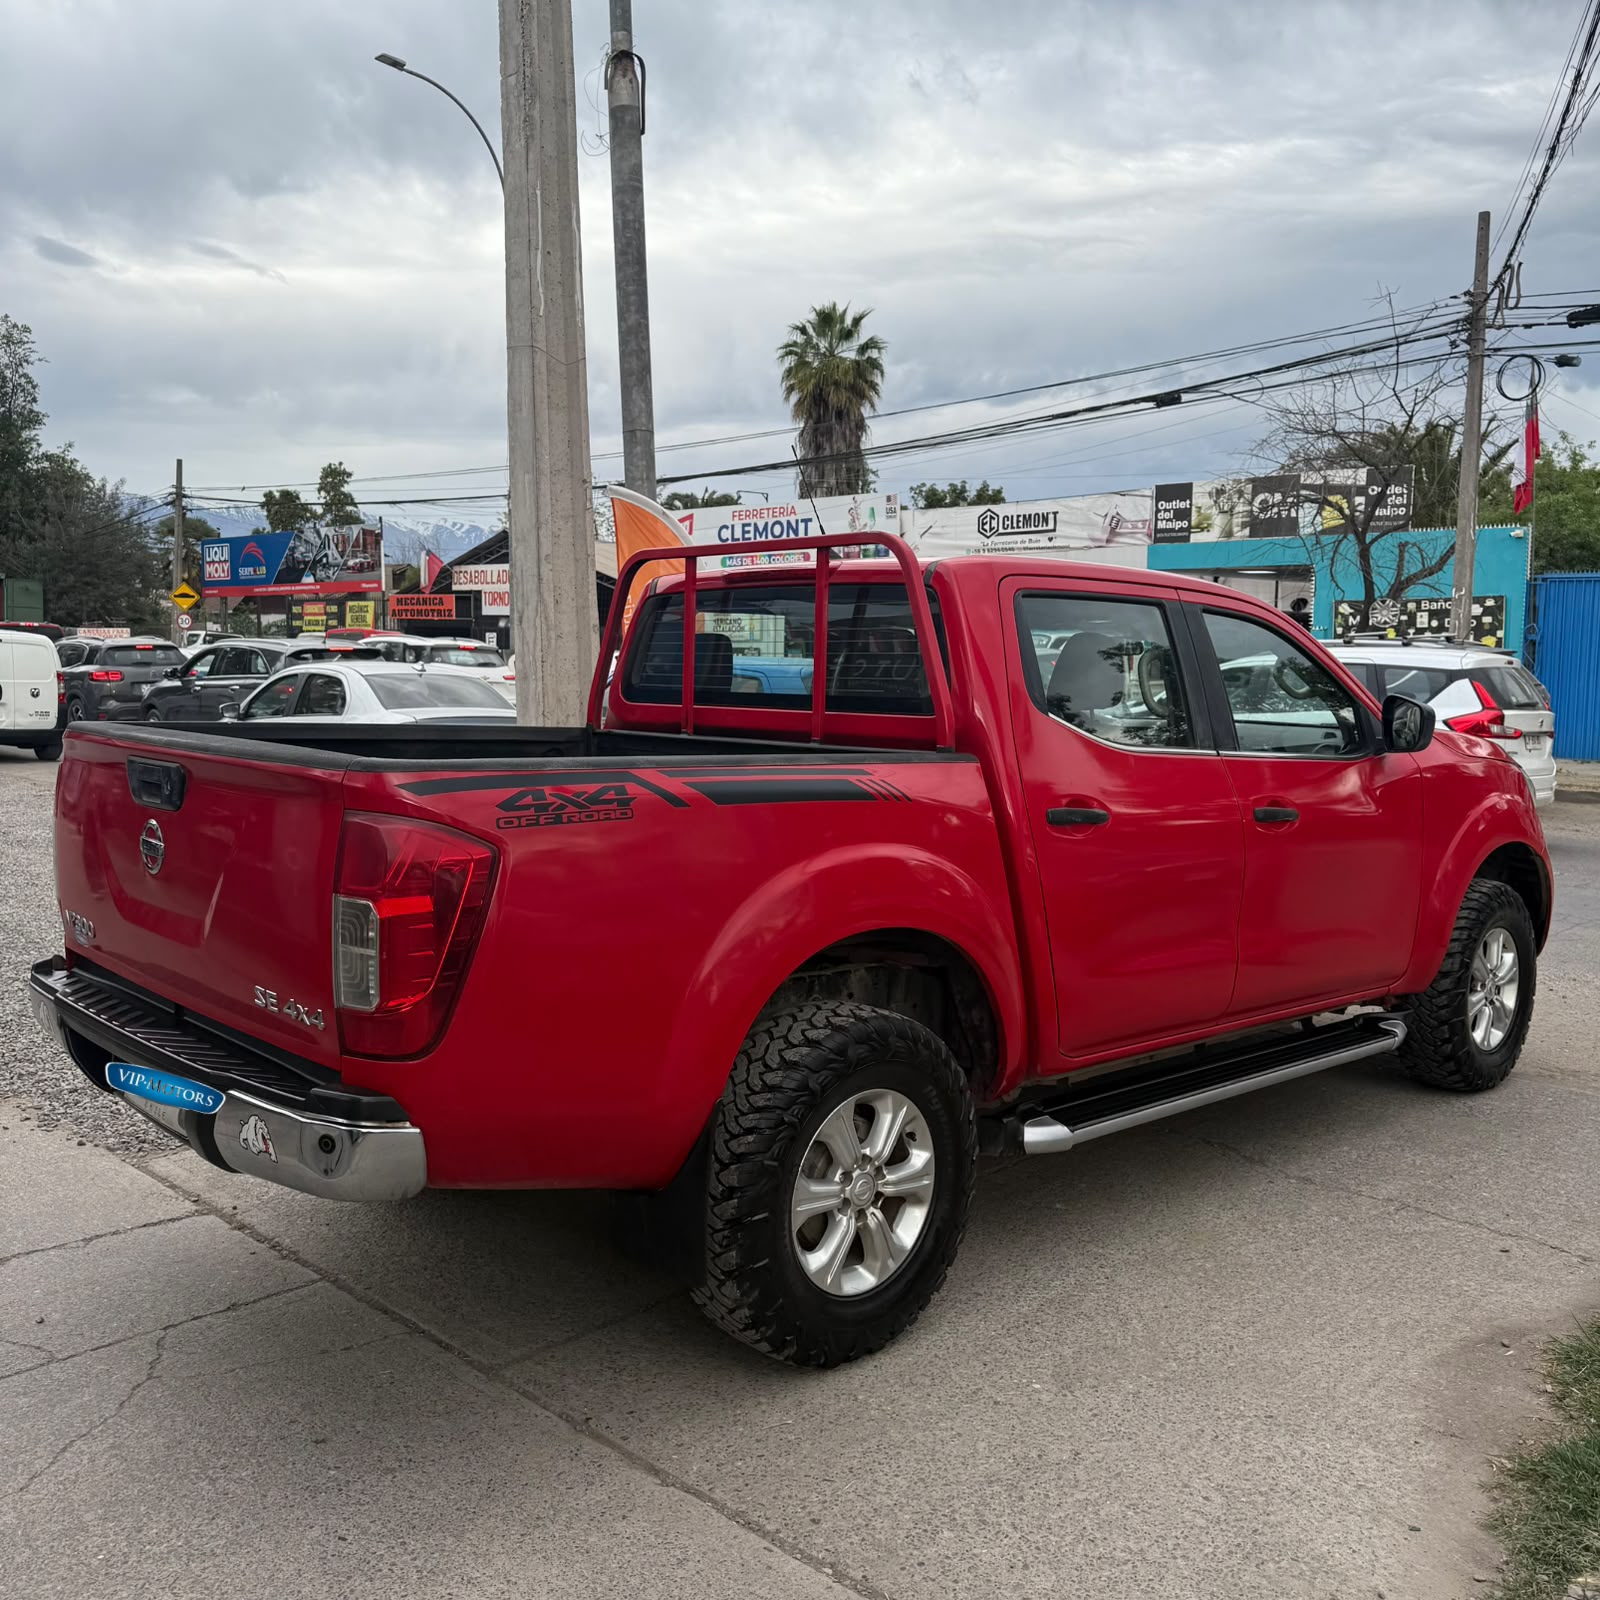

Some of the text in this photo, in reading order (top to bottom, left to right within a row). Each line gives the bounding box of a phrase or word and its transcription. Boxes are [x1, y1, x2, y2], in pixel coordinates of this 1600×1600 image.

[1158, 499, 1190, 509] Outlet
[1387, 494, 1407, 505] del
[731, 504, 797, 521] FERRETERÍA
[886, 506, 897, 514] USA
[1157, 510, 1174, 519] del
[1002, 511, 1059, 532] CLEMONT
[1157, 519, 1189, 530] Maipo
[718, 517, 812, 543] CLEMONT
[206, 546, 228, 562] LIQUI
[743, 556, 753, 566] DE
[770, 552, 804, 564] COLORES
[206, 562, 229, 578] MOLY
[396, 597, 444, 607] MECANICA
[391, 608, 453, 618] AUTOMOTRIZ
[179, 617, 190, 625] 30
[499, 809, 633, 828] OFF ROAD
[254, 985, 279, 1013] SE
